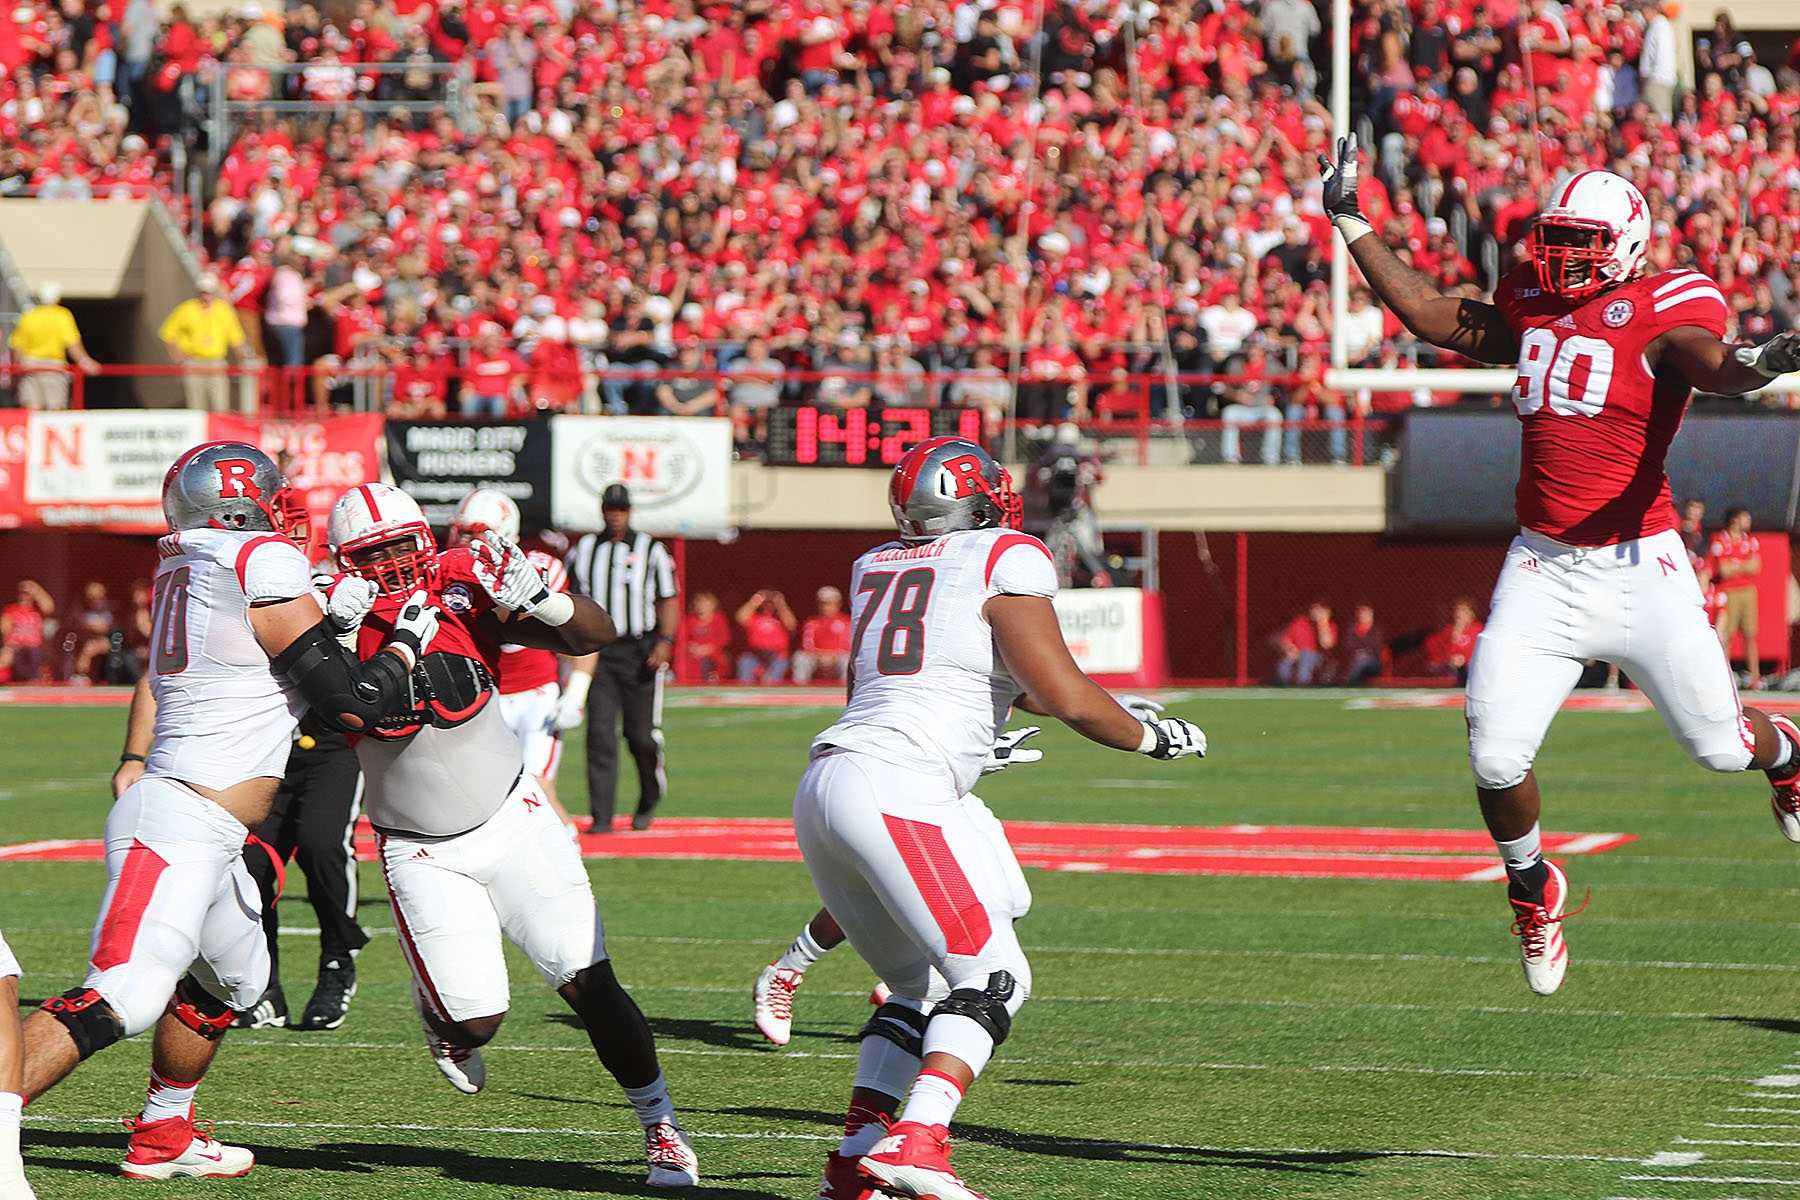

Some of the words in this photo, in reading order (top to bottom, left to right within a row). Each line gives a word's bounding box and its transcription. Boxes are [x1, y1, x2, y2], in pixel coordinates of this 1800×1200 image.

[1512, 327, 1615, 418] 90
[40, 426, 84, 470] N
[622, 447, 656, 480] N
[213, 457, 261, 499] R
[940, 454, 992, 500] R
[1657, 553, 1678, 576] N
[851, 567, 937, 676] 78
